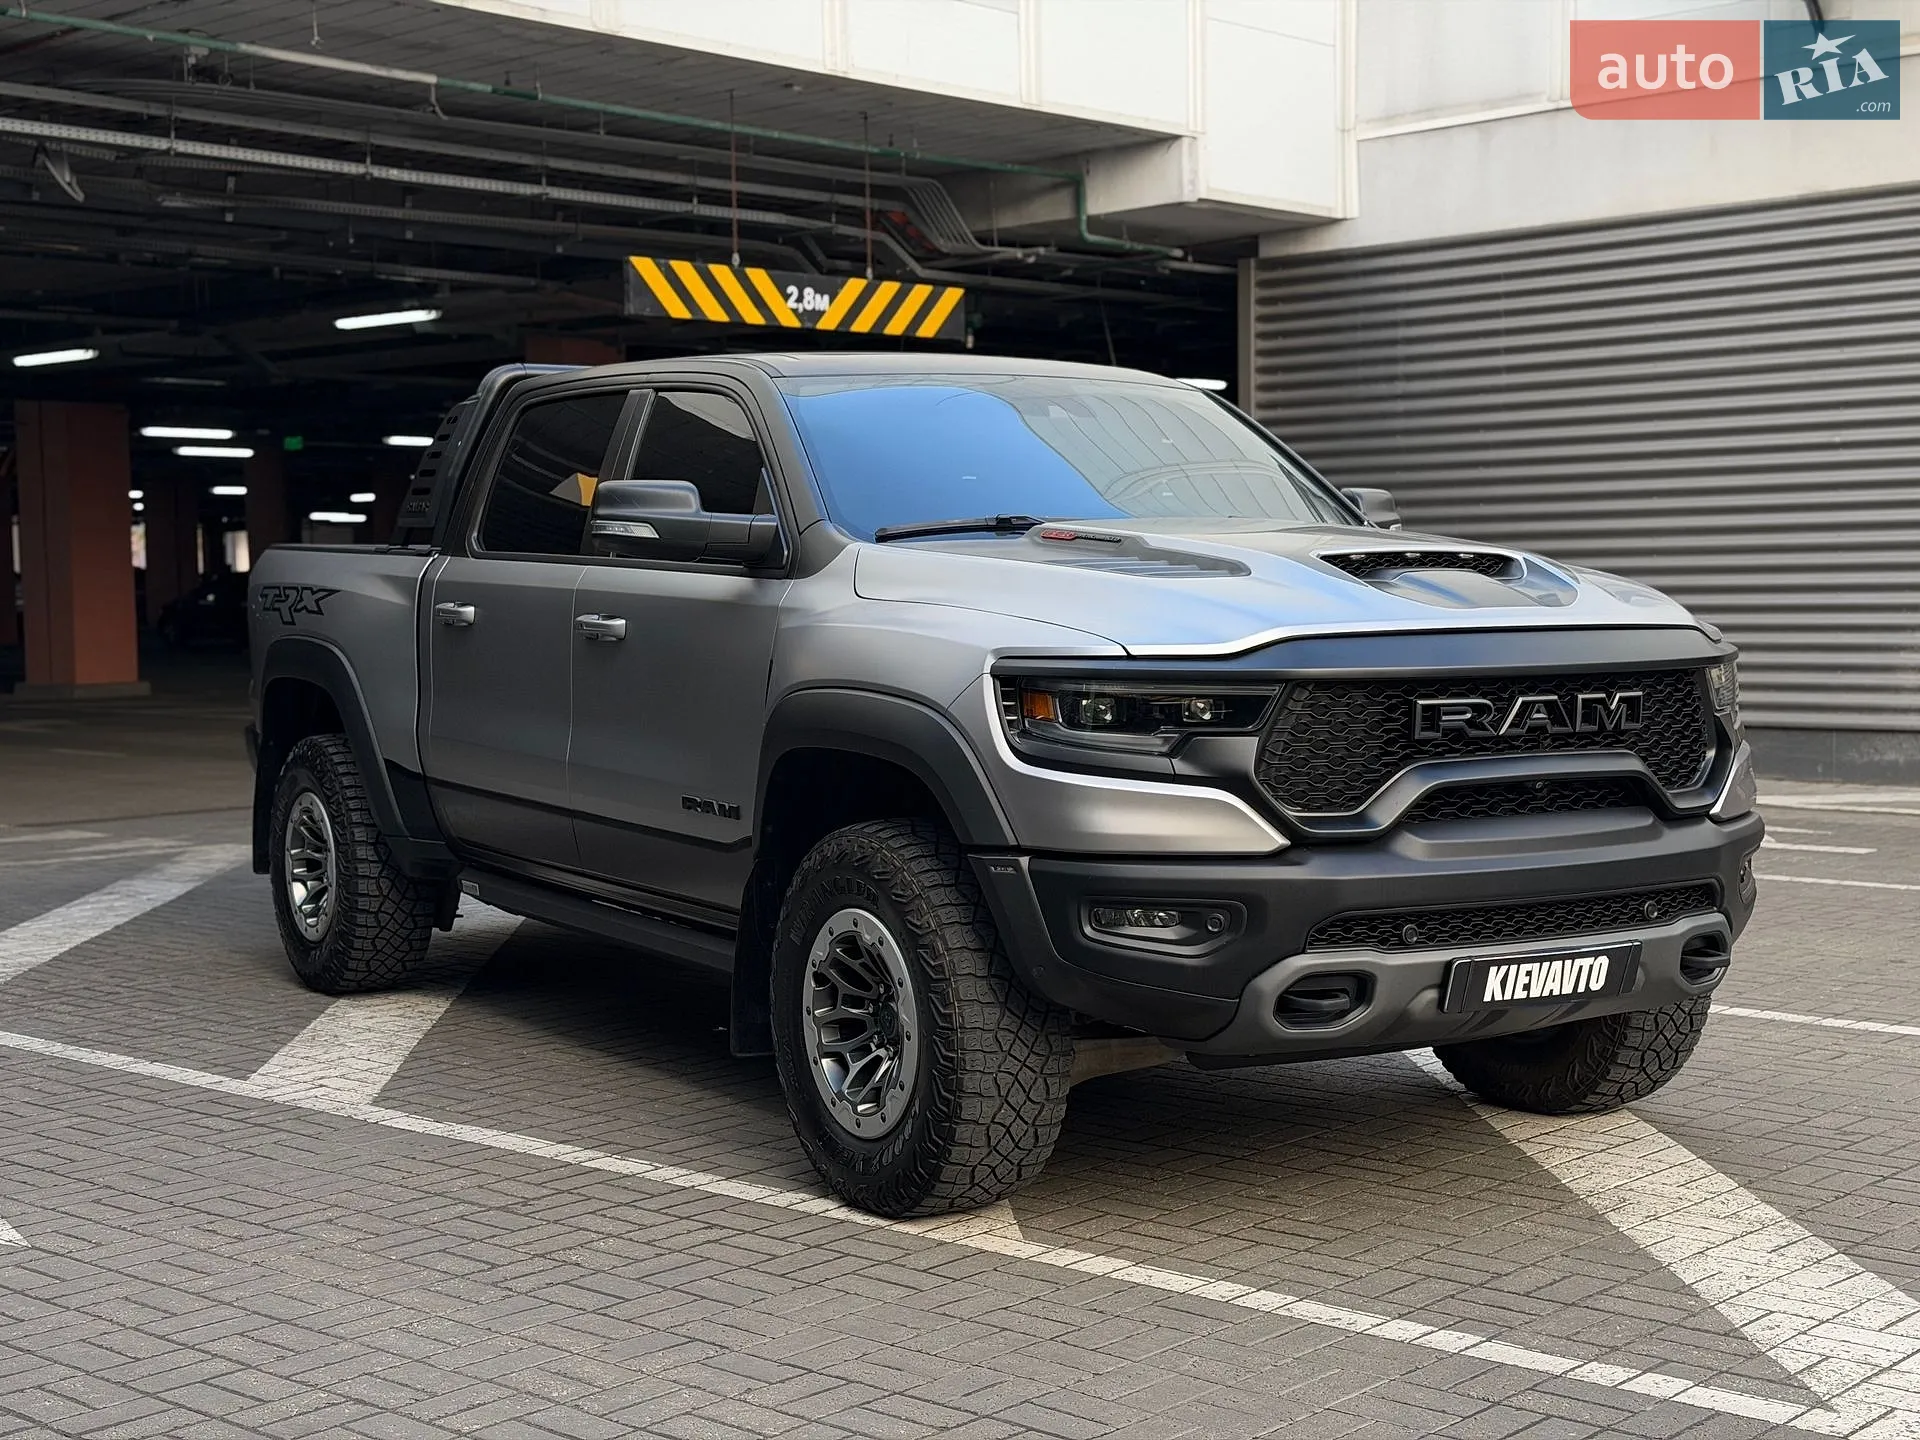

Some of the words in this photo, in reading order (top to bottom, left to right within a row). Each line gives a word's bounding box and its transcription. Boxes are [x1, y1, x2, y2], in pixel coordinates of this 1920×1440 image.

[261, 586, 341, 626] TRX
[1413, 691, 1644, 741] RAM
[681, 794, 741, 821] RAM
[1482, 955, 1610, 1003] KIEVAVTO
